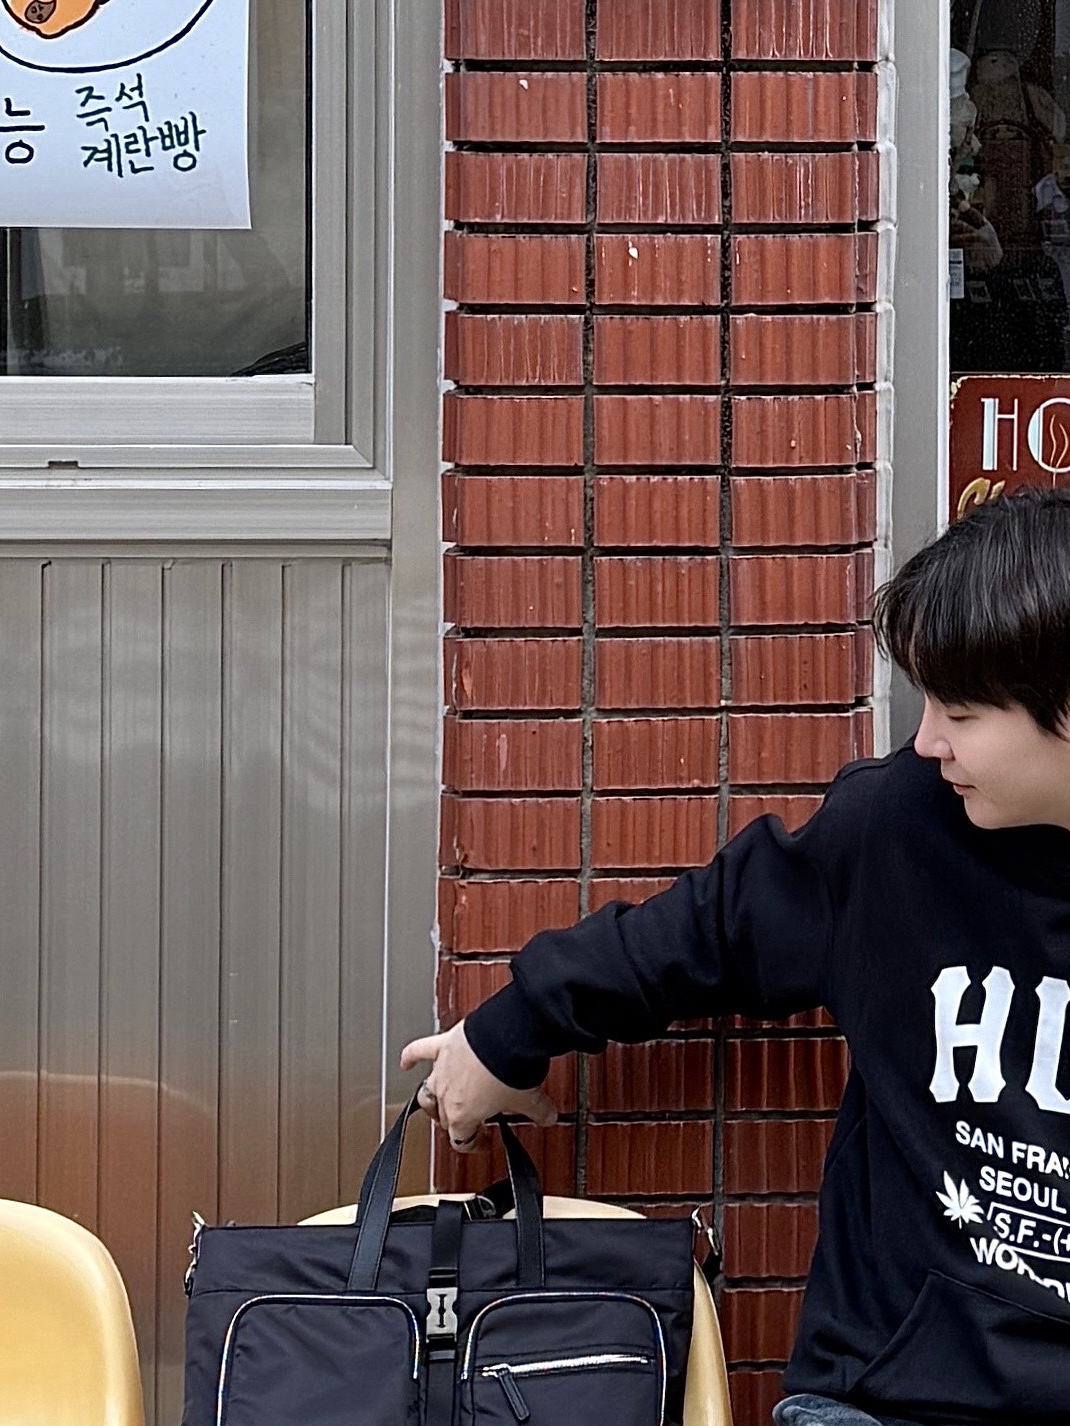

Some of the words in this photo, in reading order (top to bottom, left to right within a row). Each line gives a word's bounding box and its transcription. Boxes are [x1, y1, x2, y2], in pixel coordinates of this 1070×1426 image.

[0, 97, 46, 165] 능
[74, 72, 150, 132] 즉석
[80, 110, 207, 178] 계란빵
[955, 1120, 1004, 1159] SAN
[979, 1165, 1067, 1215] SEOUL
